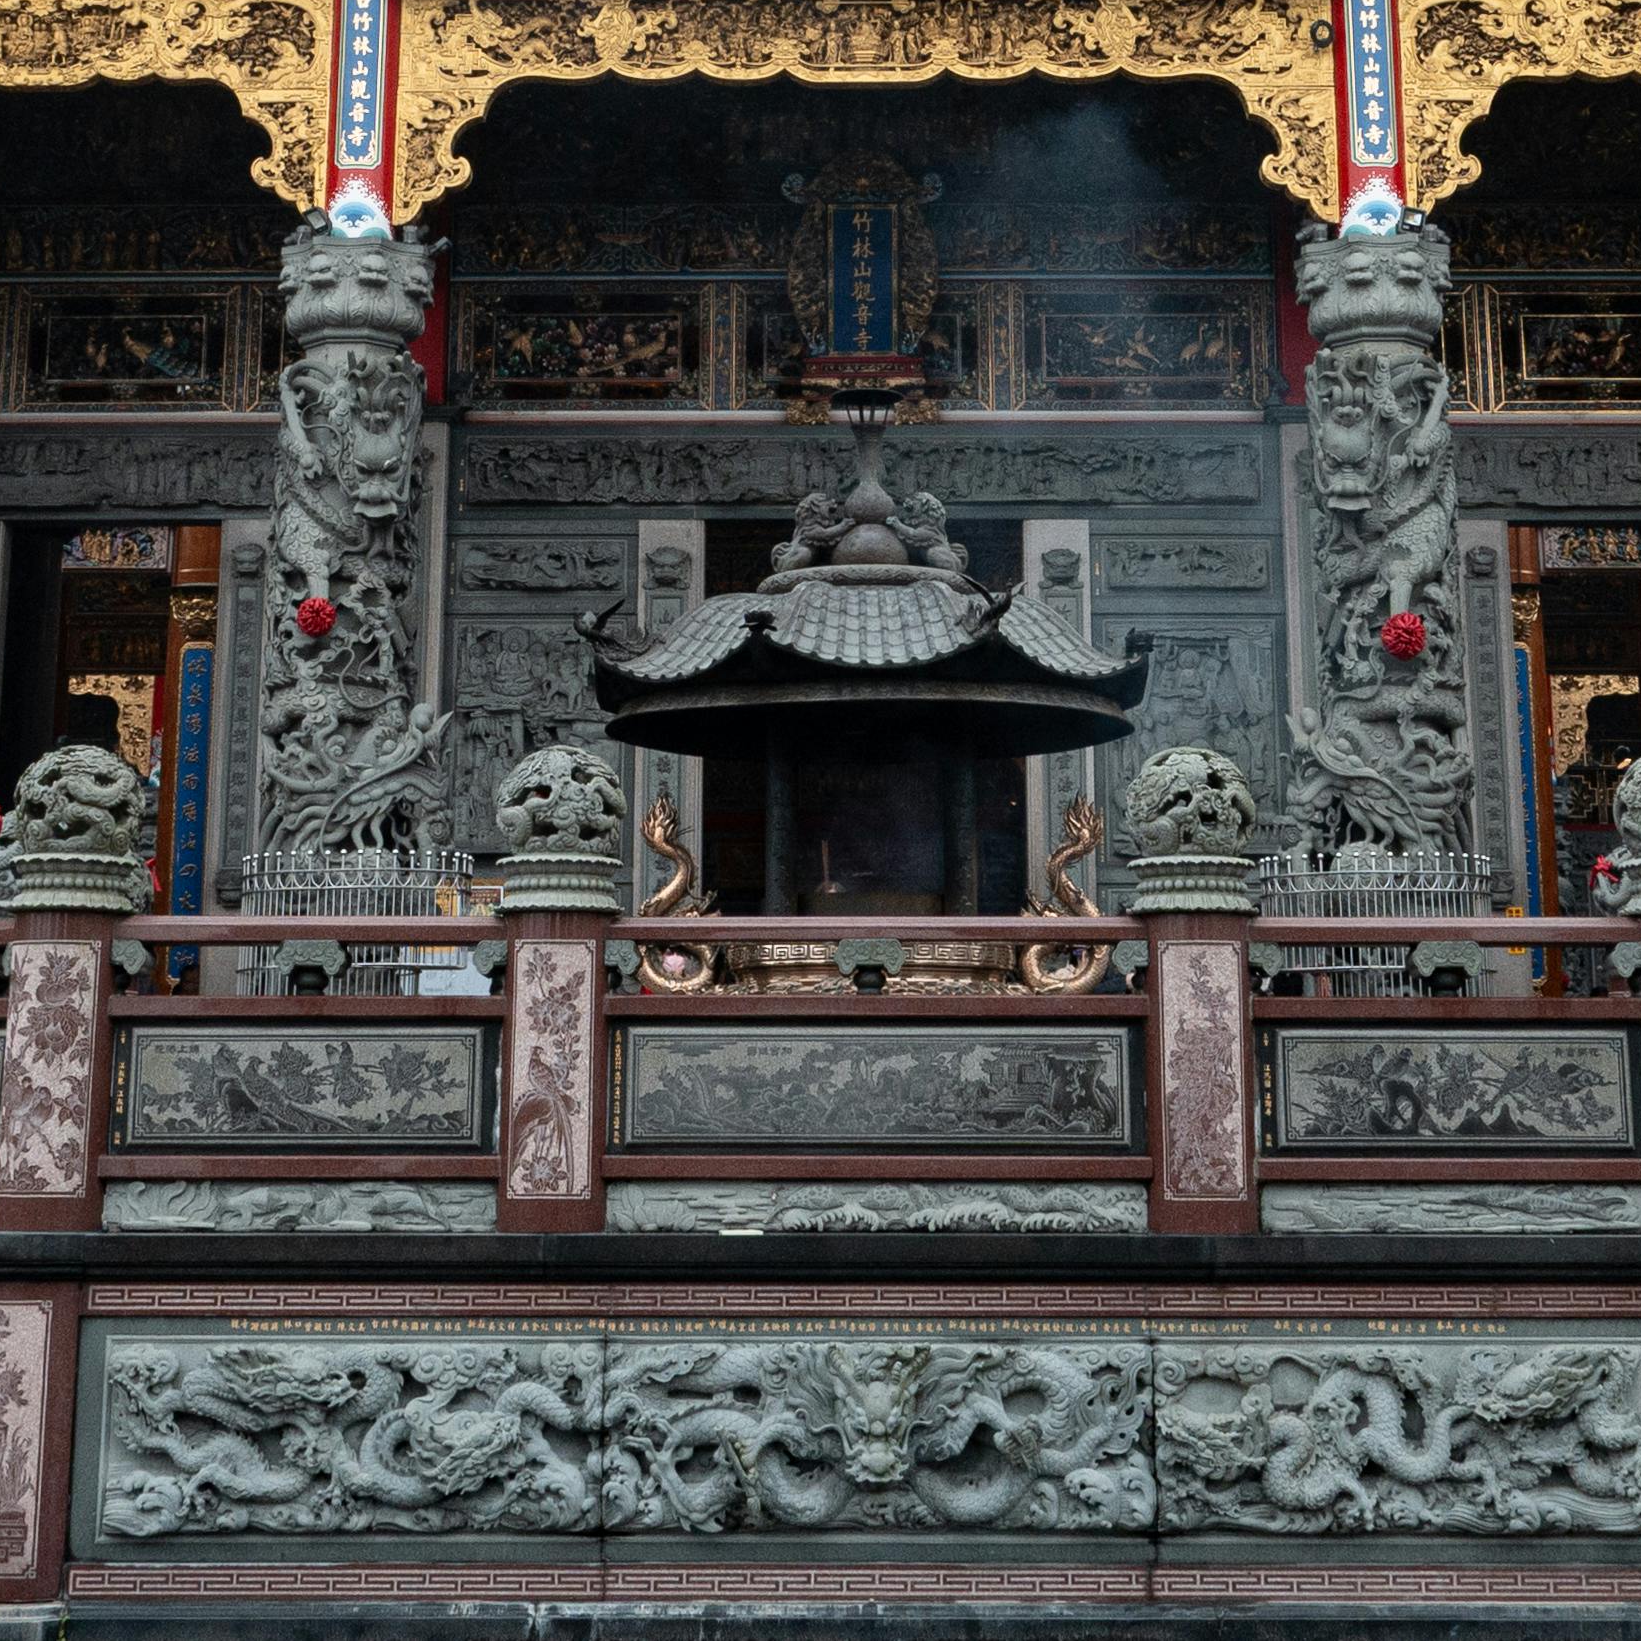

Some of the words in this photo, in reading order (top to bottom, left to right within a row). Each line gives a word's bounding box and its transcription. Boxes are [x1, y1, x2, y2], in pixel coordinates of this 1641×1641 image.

[851, 211, 876, 351] 竹林山觀音寺
